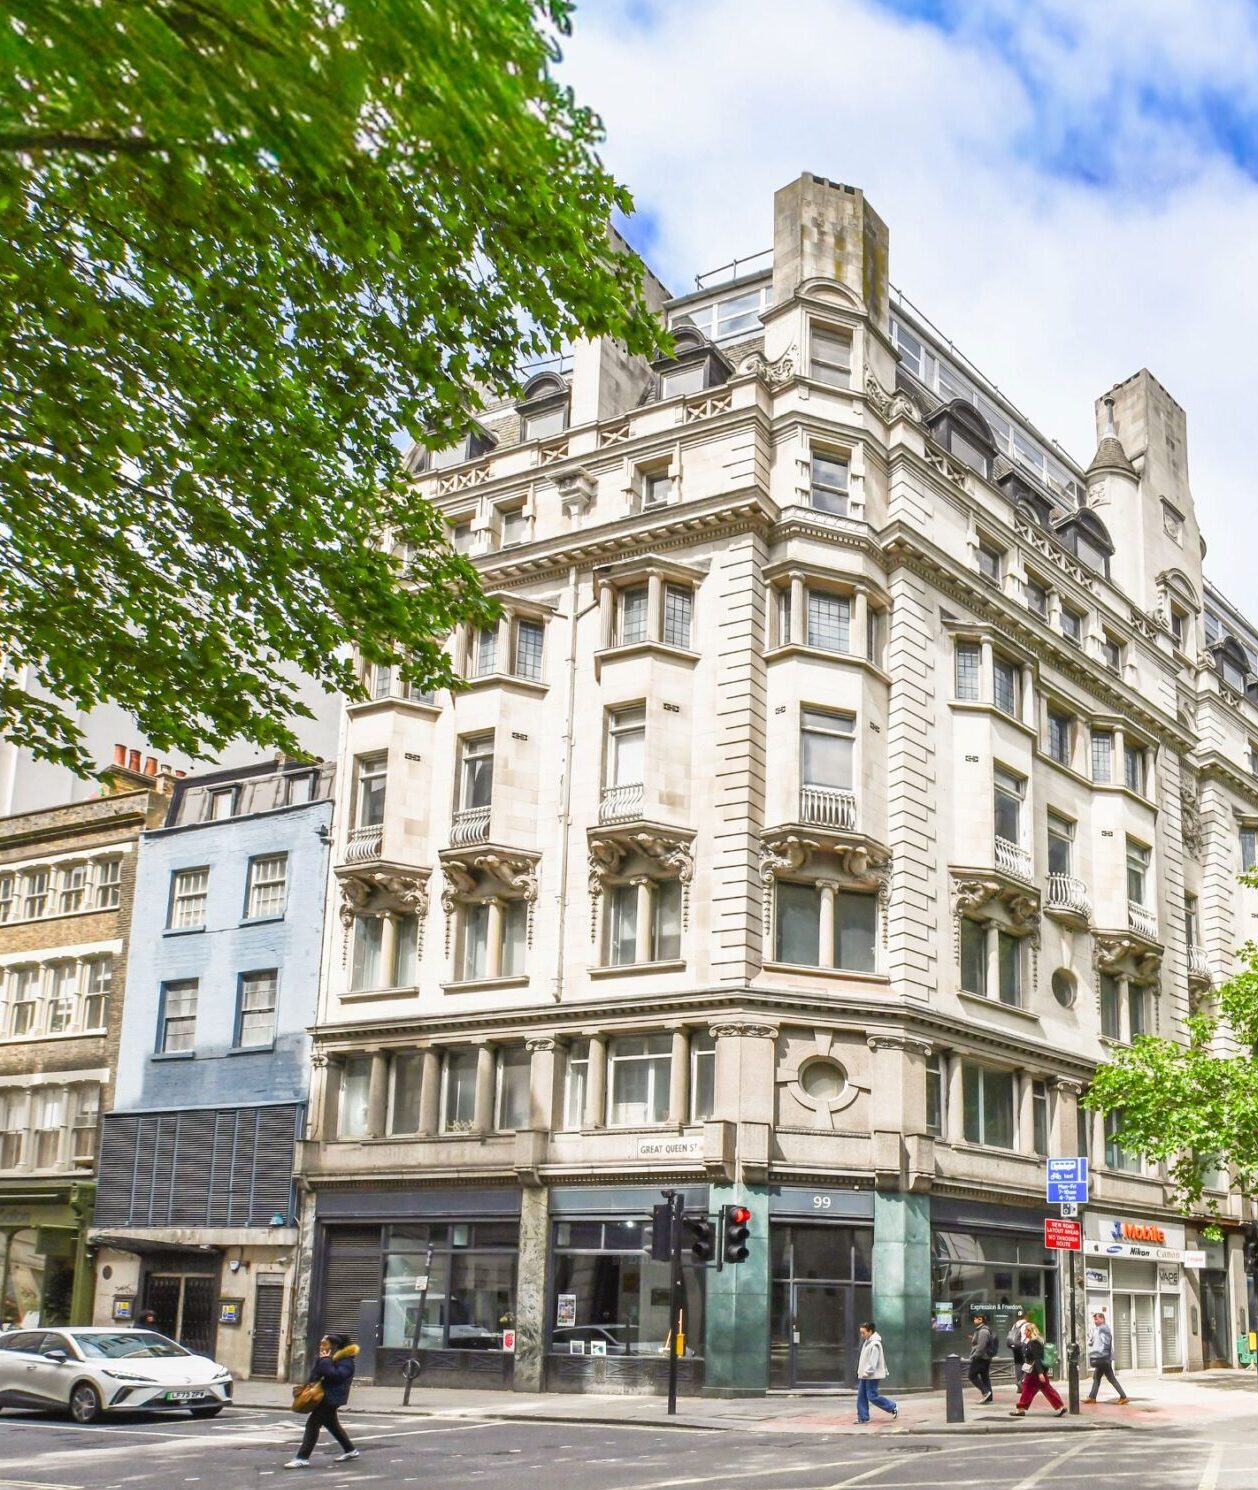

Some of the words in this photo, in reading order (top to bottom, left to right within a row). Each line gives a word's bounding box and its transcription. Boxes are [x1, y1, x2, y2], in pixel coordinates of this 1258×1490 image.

[640, 1145, 663, 1153] GREAT
[665, 1144, 687, 1153] QUEEN
[813, 1195, 831, 1209] 99
[1123, 1222, 1165, 1243] Mobile
[1056, 1240, 1071, 1248] ROUTE
[1129, 1246, 1150, 1257] Nikon
[1156, 1249, 1180, 1259] Canon
